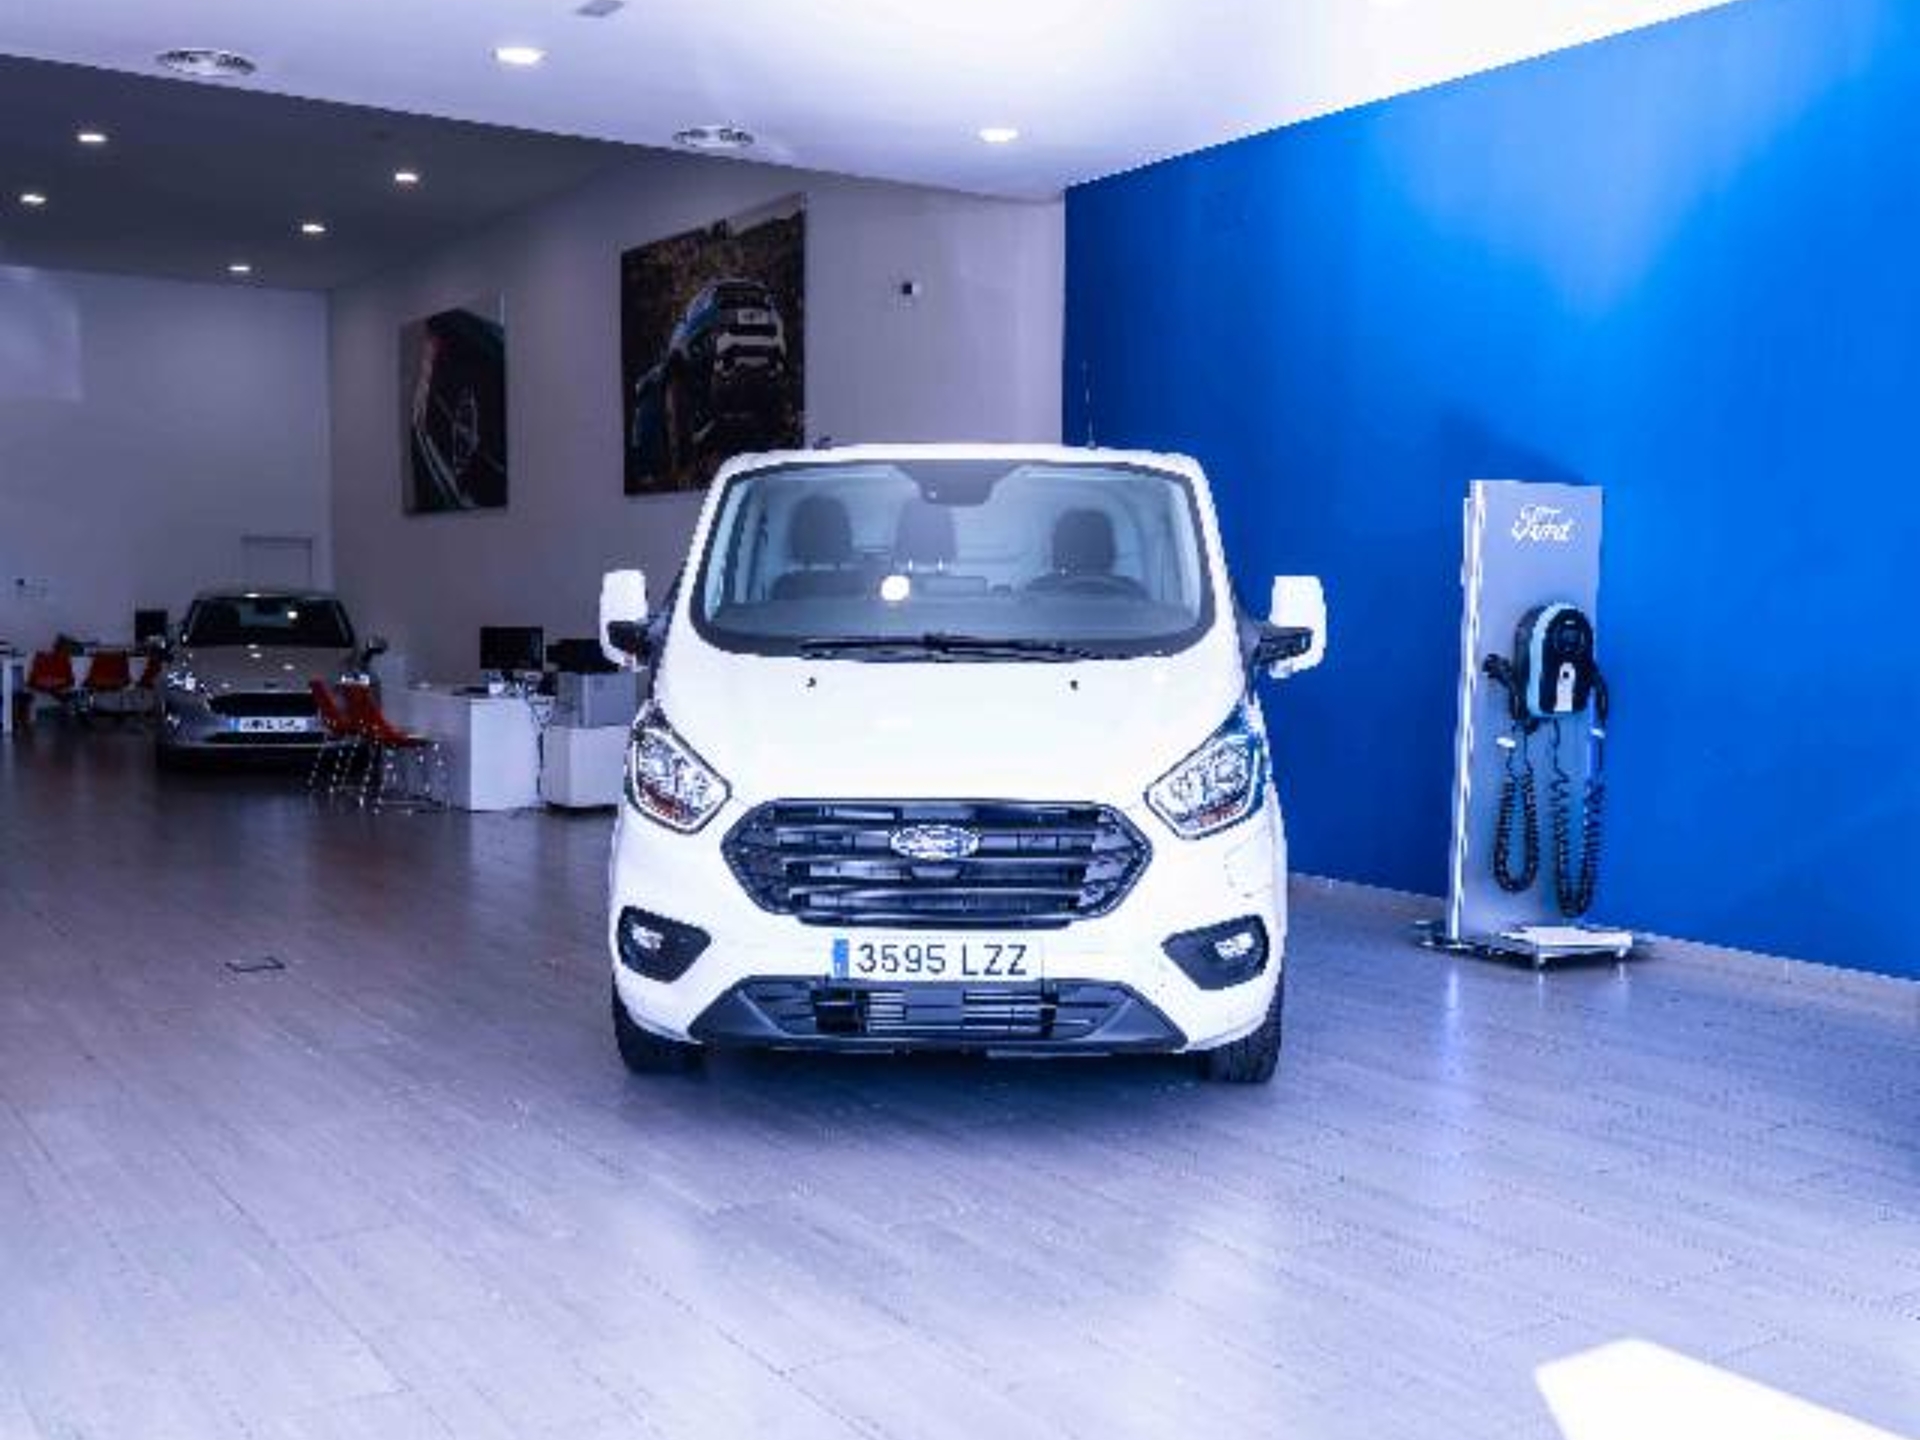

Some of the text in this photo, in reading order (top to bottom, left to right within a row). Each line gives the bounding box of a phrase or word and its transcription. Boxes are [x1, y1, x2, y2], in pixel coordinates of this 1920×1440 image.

[1511, 505, 1573, 541] Ford
[857, 943, 946, 973] 3595
[961, 943, 1027, 976] LZZ
